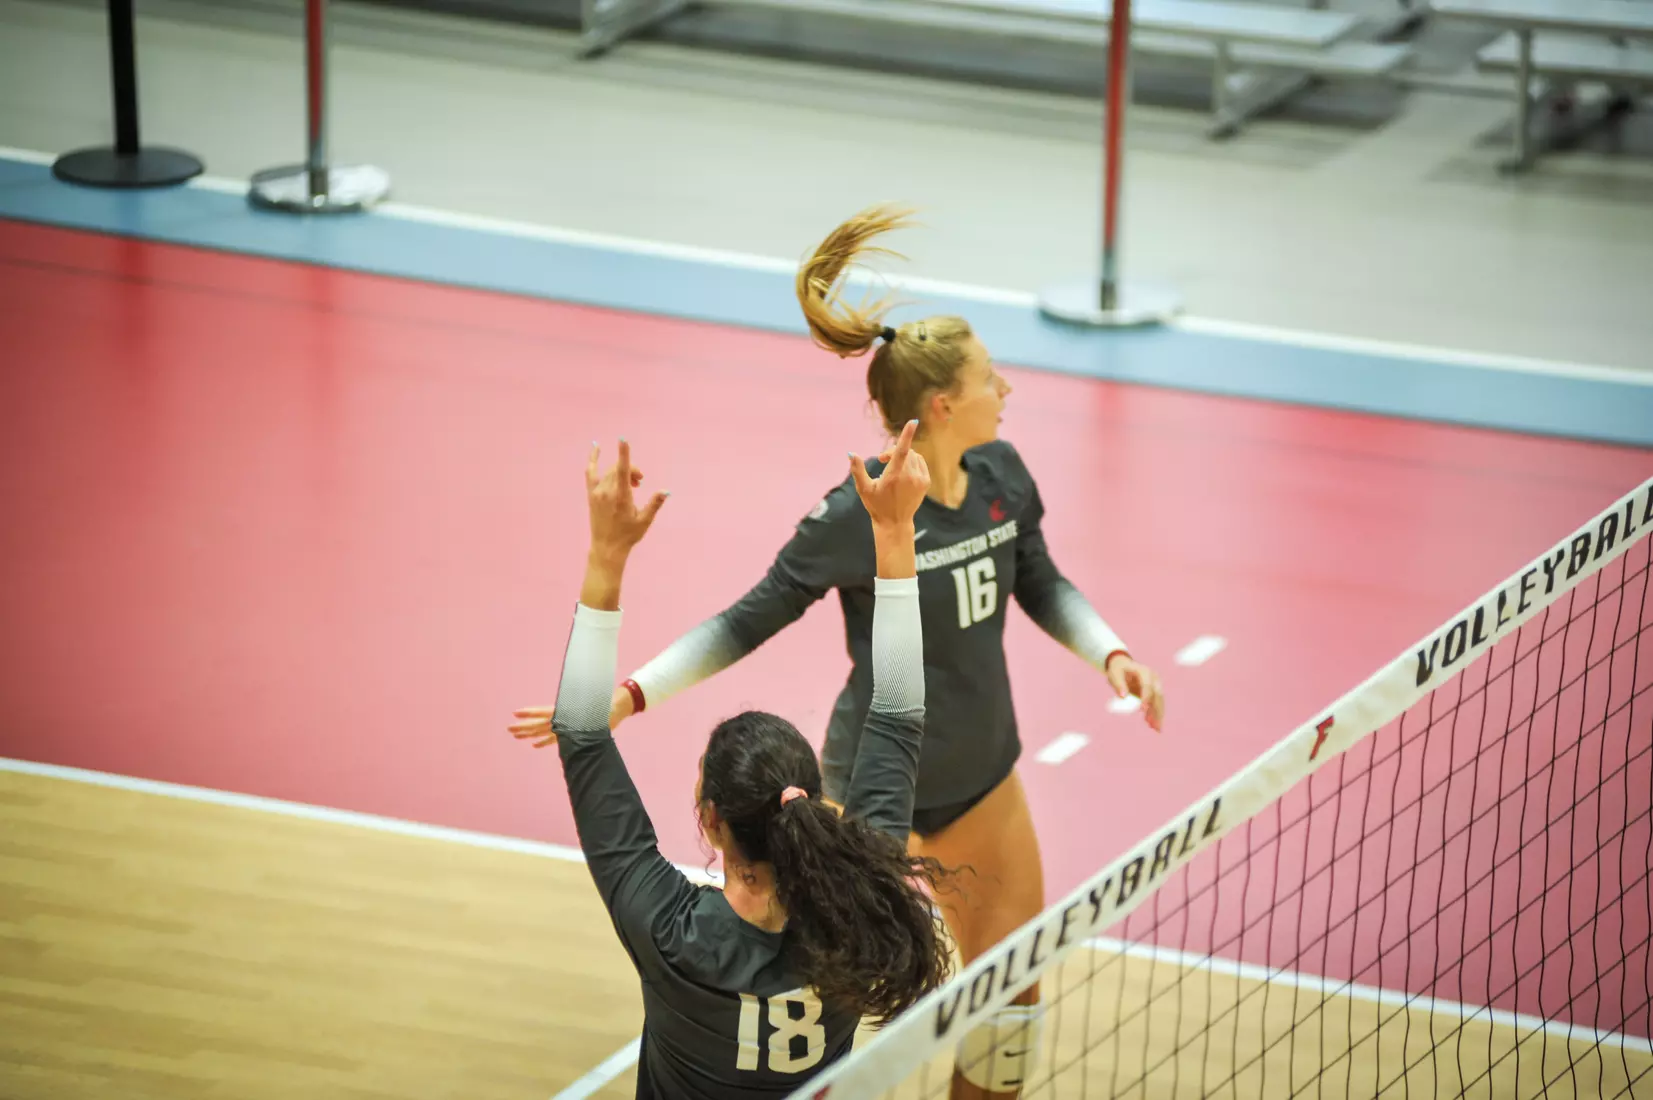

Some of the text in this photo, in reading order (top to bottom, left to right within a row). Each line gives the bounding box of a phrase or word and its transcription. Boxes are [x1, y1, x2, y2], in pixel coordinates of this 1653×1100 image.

[915, 519, 1018, 572] ASHINGTON STATE
[950, 556, 998, 629] 16
[934, 797, 1222, 1039] VOLLEYBALL
[736, 984, 826, 1074] 18
